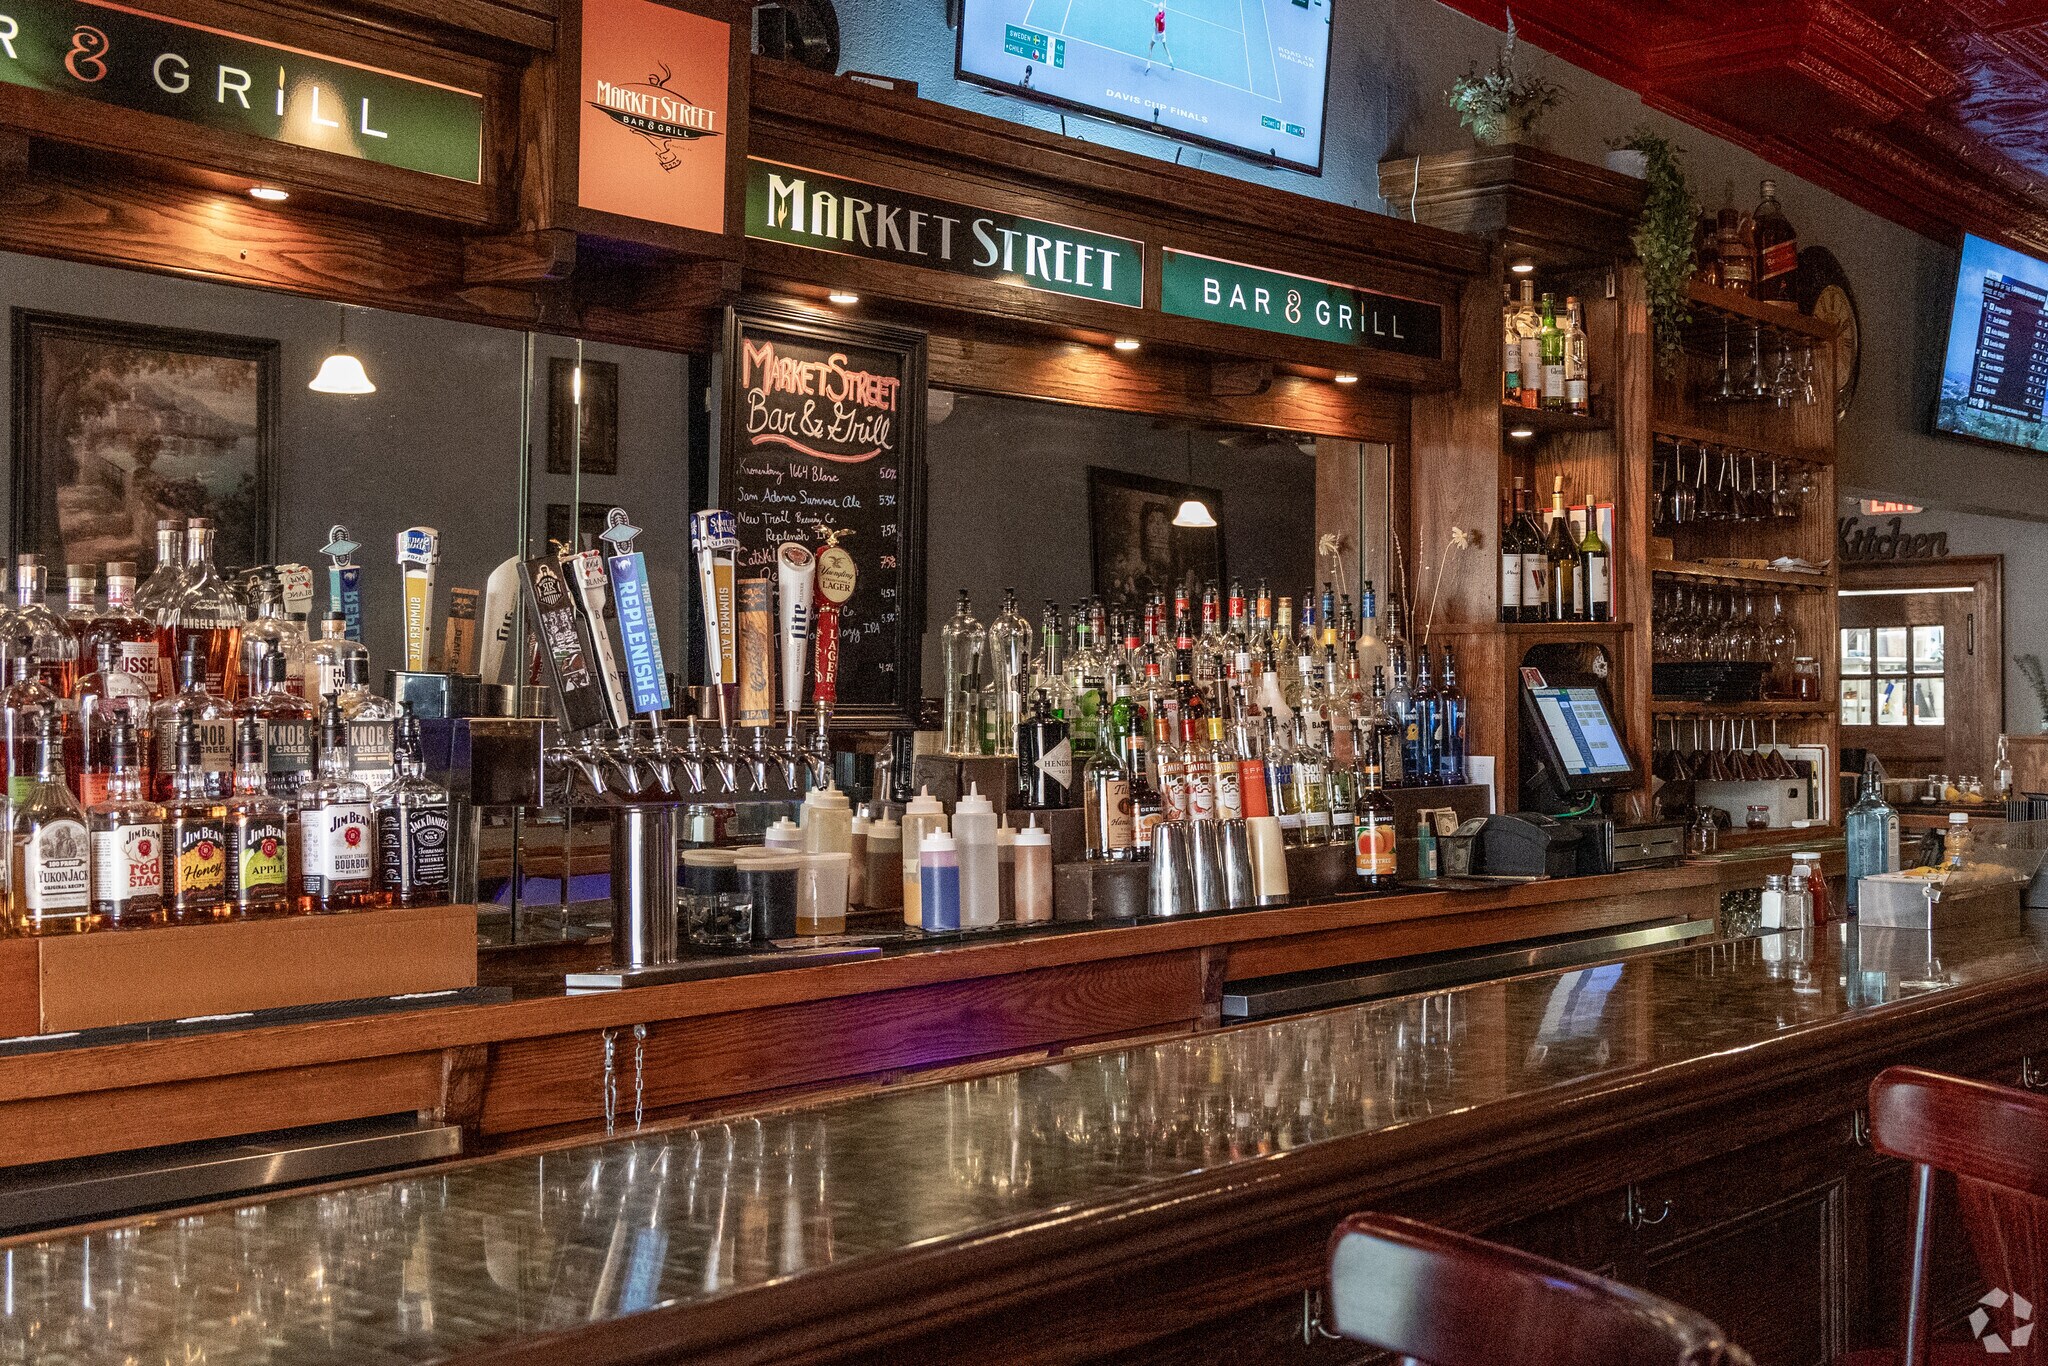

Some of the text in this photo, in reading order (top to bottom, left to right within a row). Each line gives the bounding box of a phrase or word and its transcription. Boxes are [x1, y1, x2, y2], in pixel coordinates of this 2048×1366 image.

[1010, 30, 1031, 41] SWEDEN
[1009, 44, 1023, 54] CHILE
[1278, 46, 1315, 63] ROAD TO
[153, 53, 388, 139] GRILL
[1106, 89, 1208, 124] DAVIS CUP FINALS
[623, 115, 645, 128] BAR
[658, 123, 689, 138] GRILL
[767, 173, 1120, 291] MARKET STREET
[1204, 277, 1405, 339] BAR & GRILL
[746, 387, 799, 436] Bar
[827, 401, 894, 450] Grill
[789, 463, 809, 479] 1664
[811, 465, 840, 482] Blanc
[737, 486, 759, 502] Sam
[761, 487, 797, 503] Adams
[799, 489, 840, 508] Summer
[710, 517, 737, 528] SAMUEL
[737, 510, 760, 525] New
[761, 509, 791, 524] Trail
[824, 512, 837, 524] Co.
[712, 525, 736, 535] ADAMS
[765, 527, 810, 545] Replenish
[1838, 516, 1949, 561] Kitchen
[820, 565, 855, 580] Yuengling
[585, 576, 607, 587] BLANC
[822, 580, 851, 593] LAGER
[719, 587, 732, 661] SUMMER ALE
[863, 621, 882, 635] IPA
[620, 580, 655, 691] REPLENISH
[828, 630, 838, 683] LAGER
[638, 693, 659, 706] IPA
[269, 725, 305, 746] KNOB
[351, 725, 385, 747] KNOB
[275, 744, 311, 754] CREEK
[357, 745, 391, 754] CREEK
[296, 756, 308, 765] RYE
[330, 815, 348, 833] JIM
[409, 818, 426, 834] JACK
[126, 828, 141, 845] JIM
[182, 831, 200, 849] JIM
[247, 829, 264, 846] JIM
[129, 858, 160, 875] red
[183, 862, 223, 881] Honey
[251, 863, 285, 875] APPLE
[335, 859, 370, 870] BOURBON
[39, 870, 68, 884] YUKON
[129, 875, 161, 888] STAG
